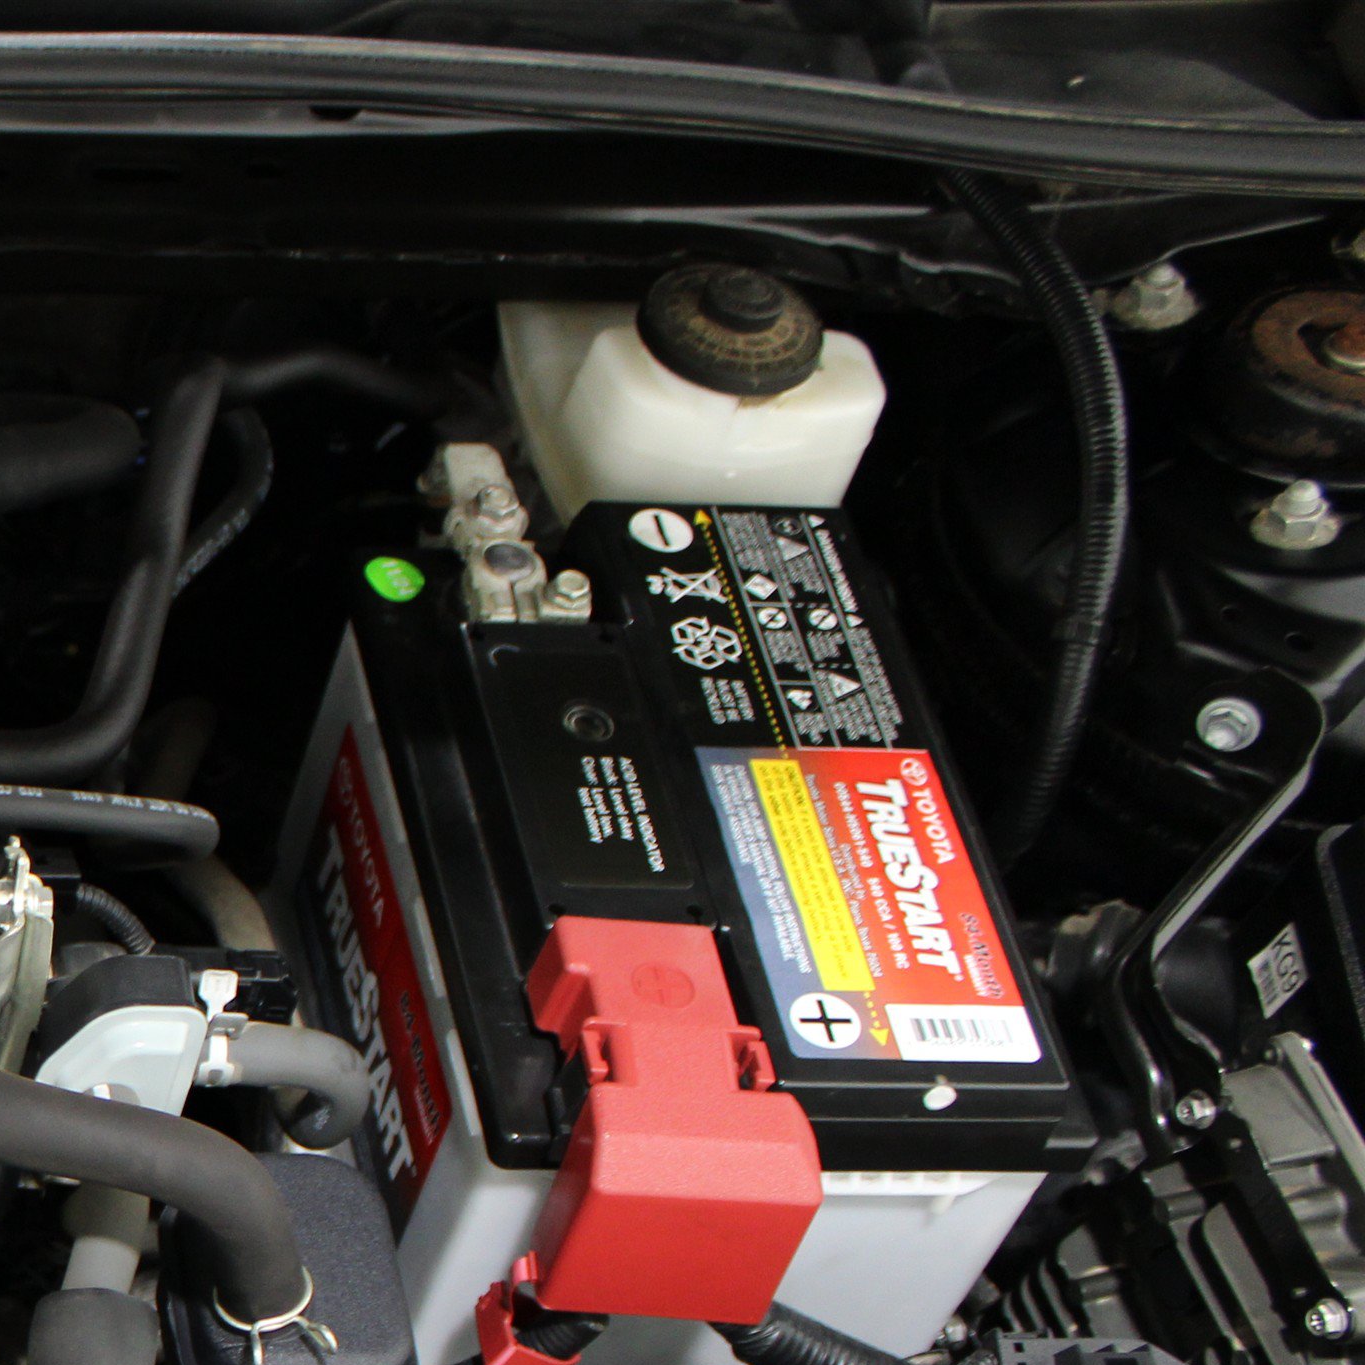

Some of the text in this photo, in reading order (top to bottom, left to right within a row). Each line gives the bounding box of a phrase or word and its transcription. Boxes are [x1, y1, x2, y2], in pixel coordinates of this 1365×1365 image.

[912, 791, 956, 864] TOYOTA
[856, 778, 957, 975] TRUESTART
[1272, 930, 1301, 994] KG9
